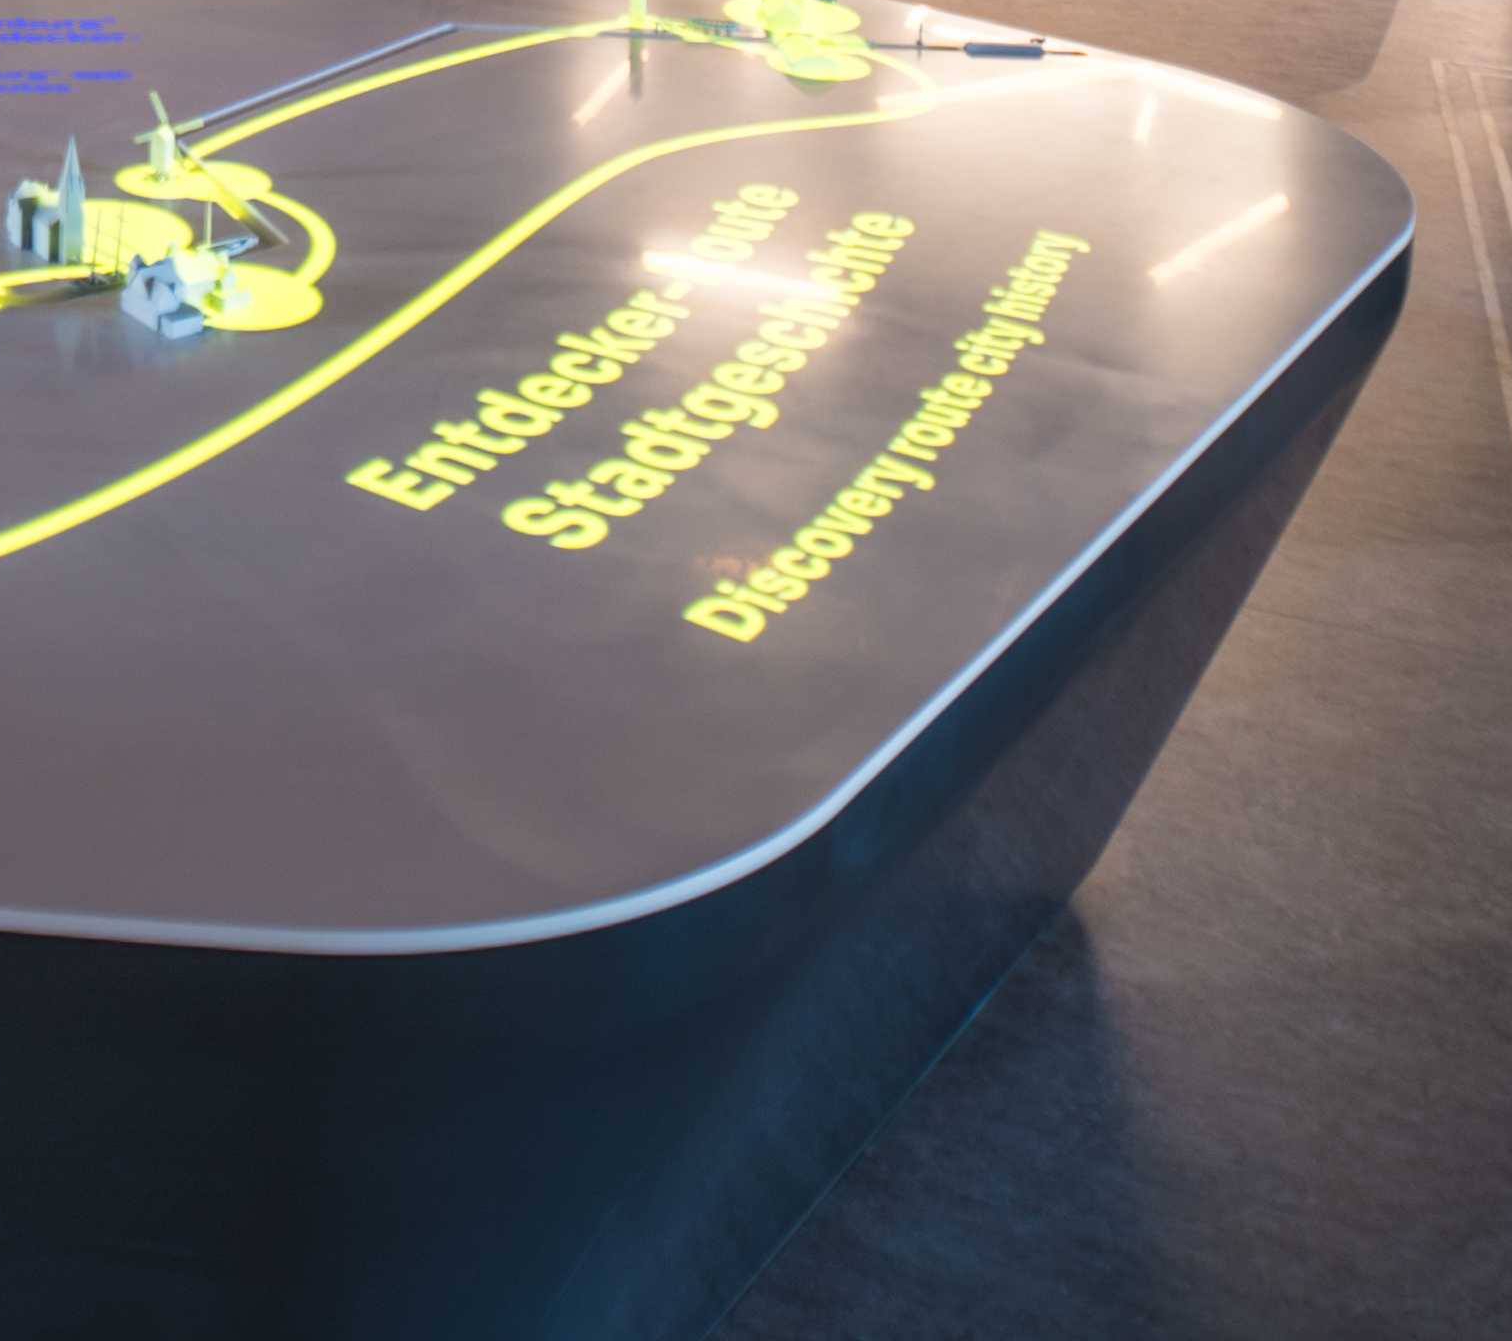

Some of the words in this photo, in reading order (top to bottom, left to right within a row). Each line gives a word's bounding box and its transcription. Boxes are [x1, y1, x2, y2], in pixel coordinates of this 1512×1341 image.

[982, 228, 1093, 323] history
[345, 183, 800, 511] Entdecker-oute
[501, 209, 916, 549] Stadtgeschichte
[887, 372, 994, 462] route
[953, 318, 1046, 377] city
[683, 453, 936, 643] Discovery
